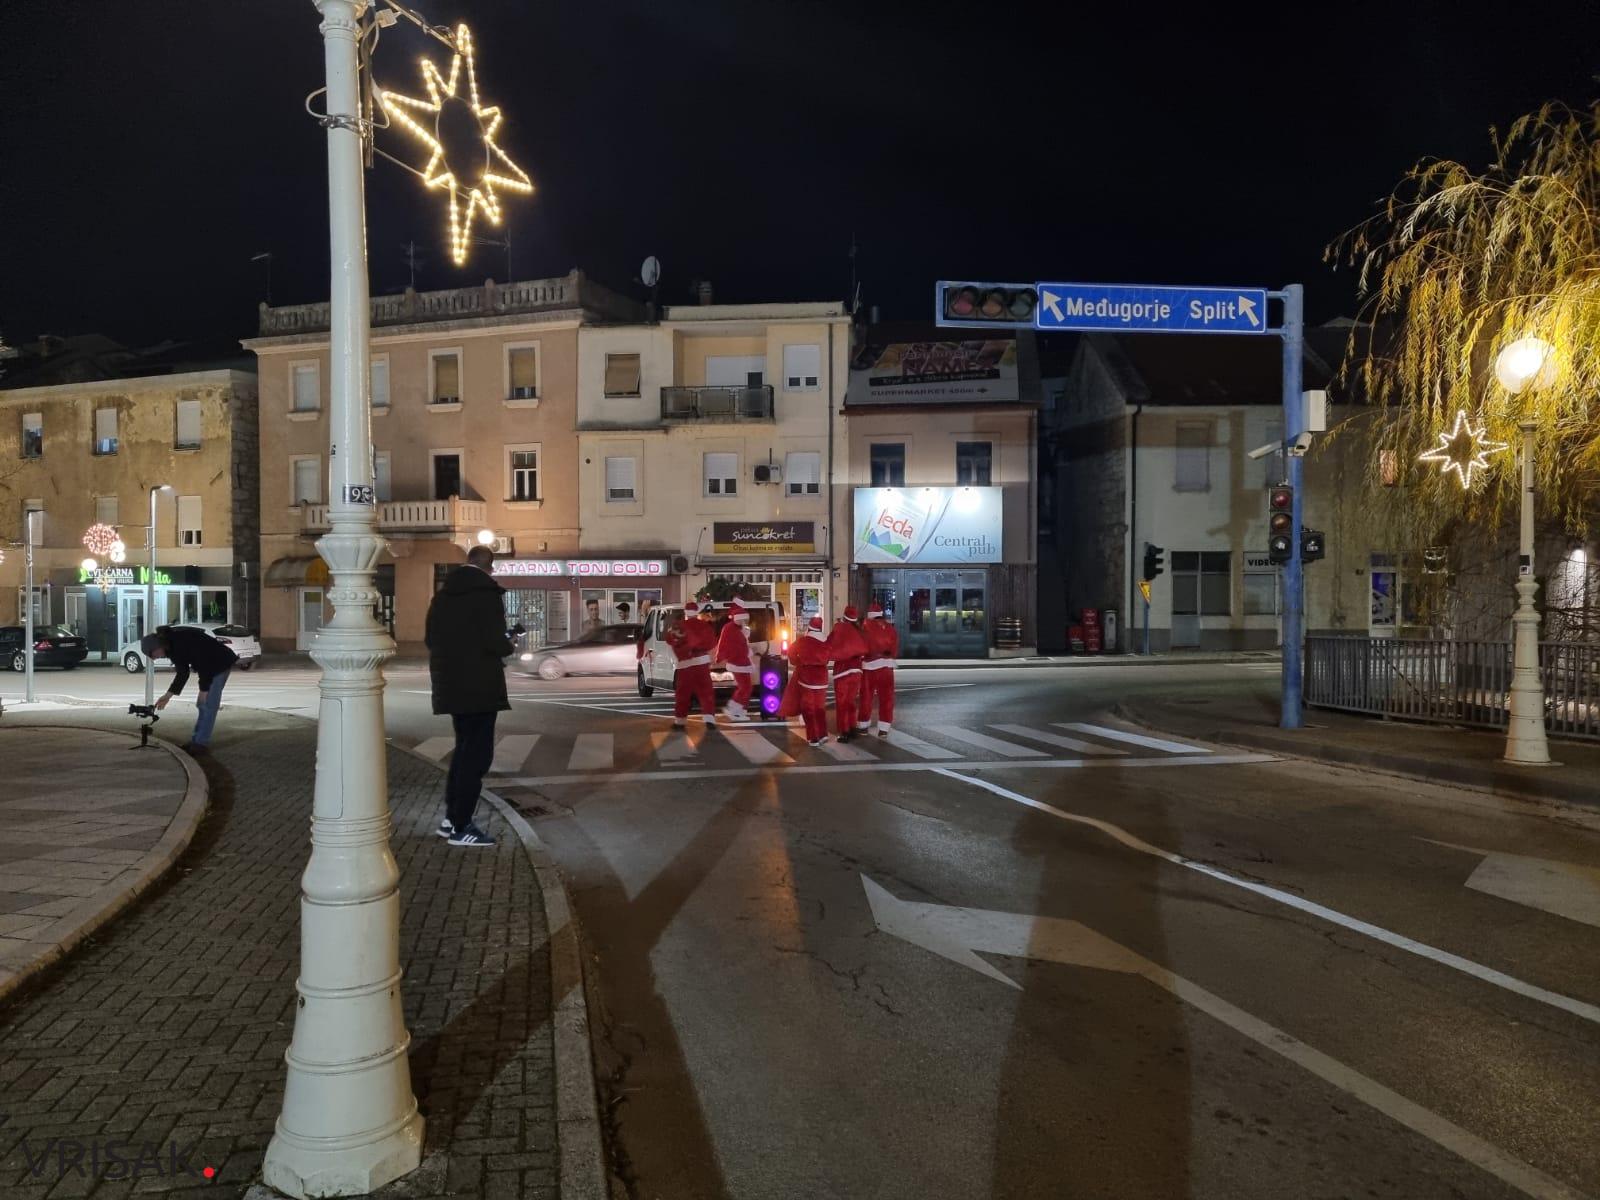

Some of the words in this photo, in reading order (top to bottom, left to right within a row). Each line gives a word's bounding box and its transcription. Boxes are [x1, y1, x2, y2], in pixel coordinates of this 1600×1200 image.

[1066, 297, 1171, 322] Međugorje
[1190, 299, 1236, 324] Split
[877, 507, 913, 539] leda
[934, 535, 986, 547] Central
[969, 543, 996, 557] pub
[567, 562, 609, 575] TONI
[613, 562, 660, 575] GOLD
